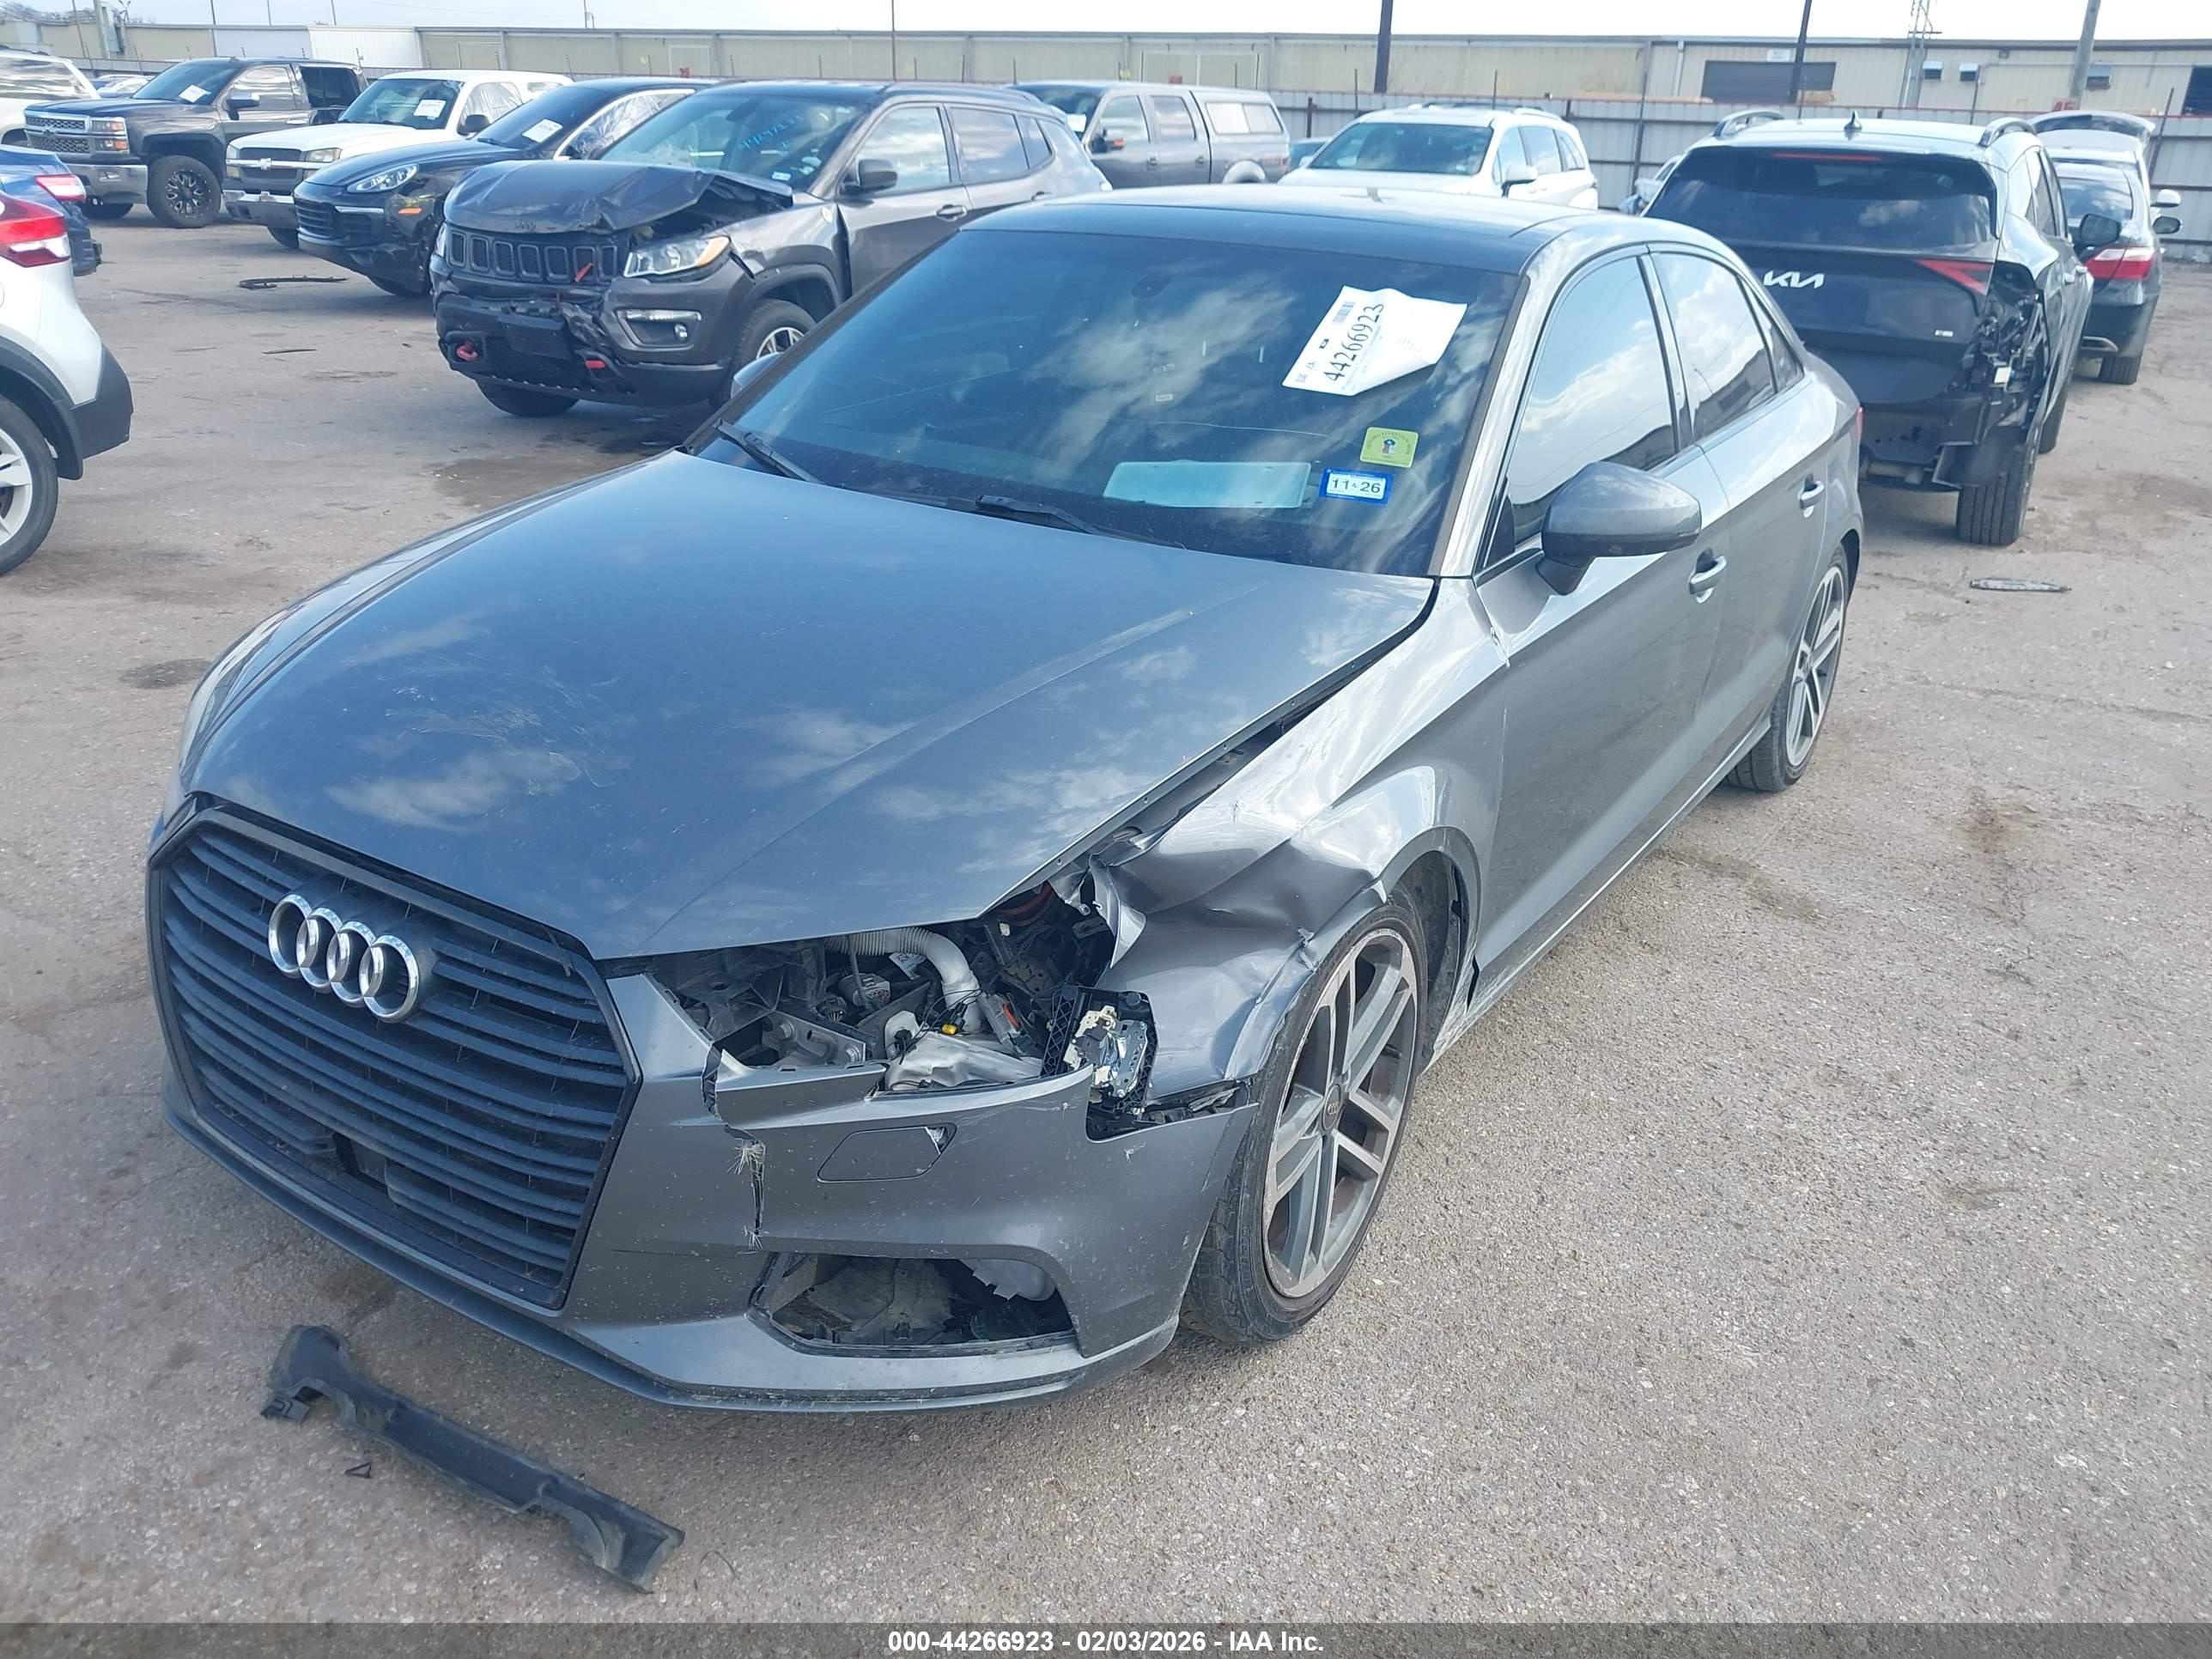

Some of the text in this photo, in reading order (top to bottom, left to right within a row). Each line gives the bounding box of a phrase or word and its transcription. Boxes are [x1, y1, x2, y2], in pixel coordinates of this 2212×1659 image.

[1763, 270, 1825, 289] KIA
[1323, 303, 1384, 381] 44266923
[1332, 479, 1382, 494] 11 26
